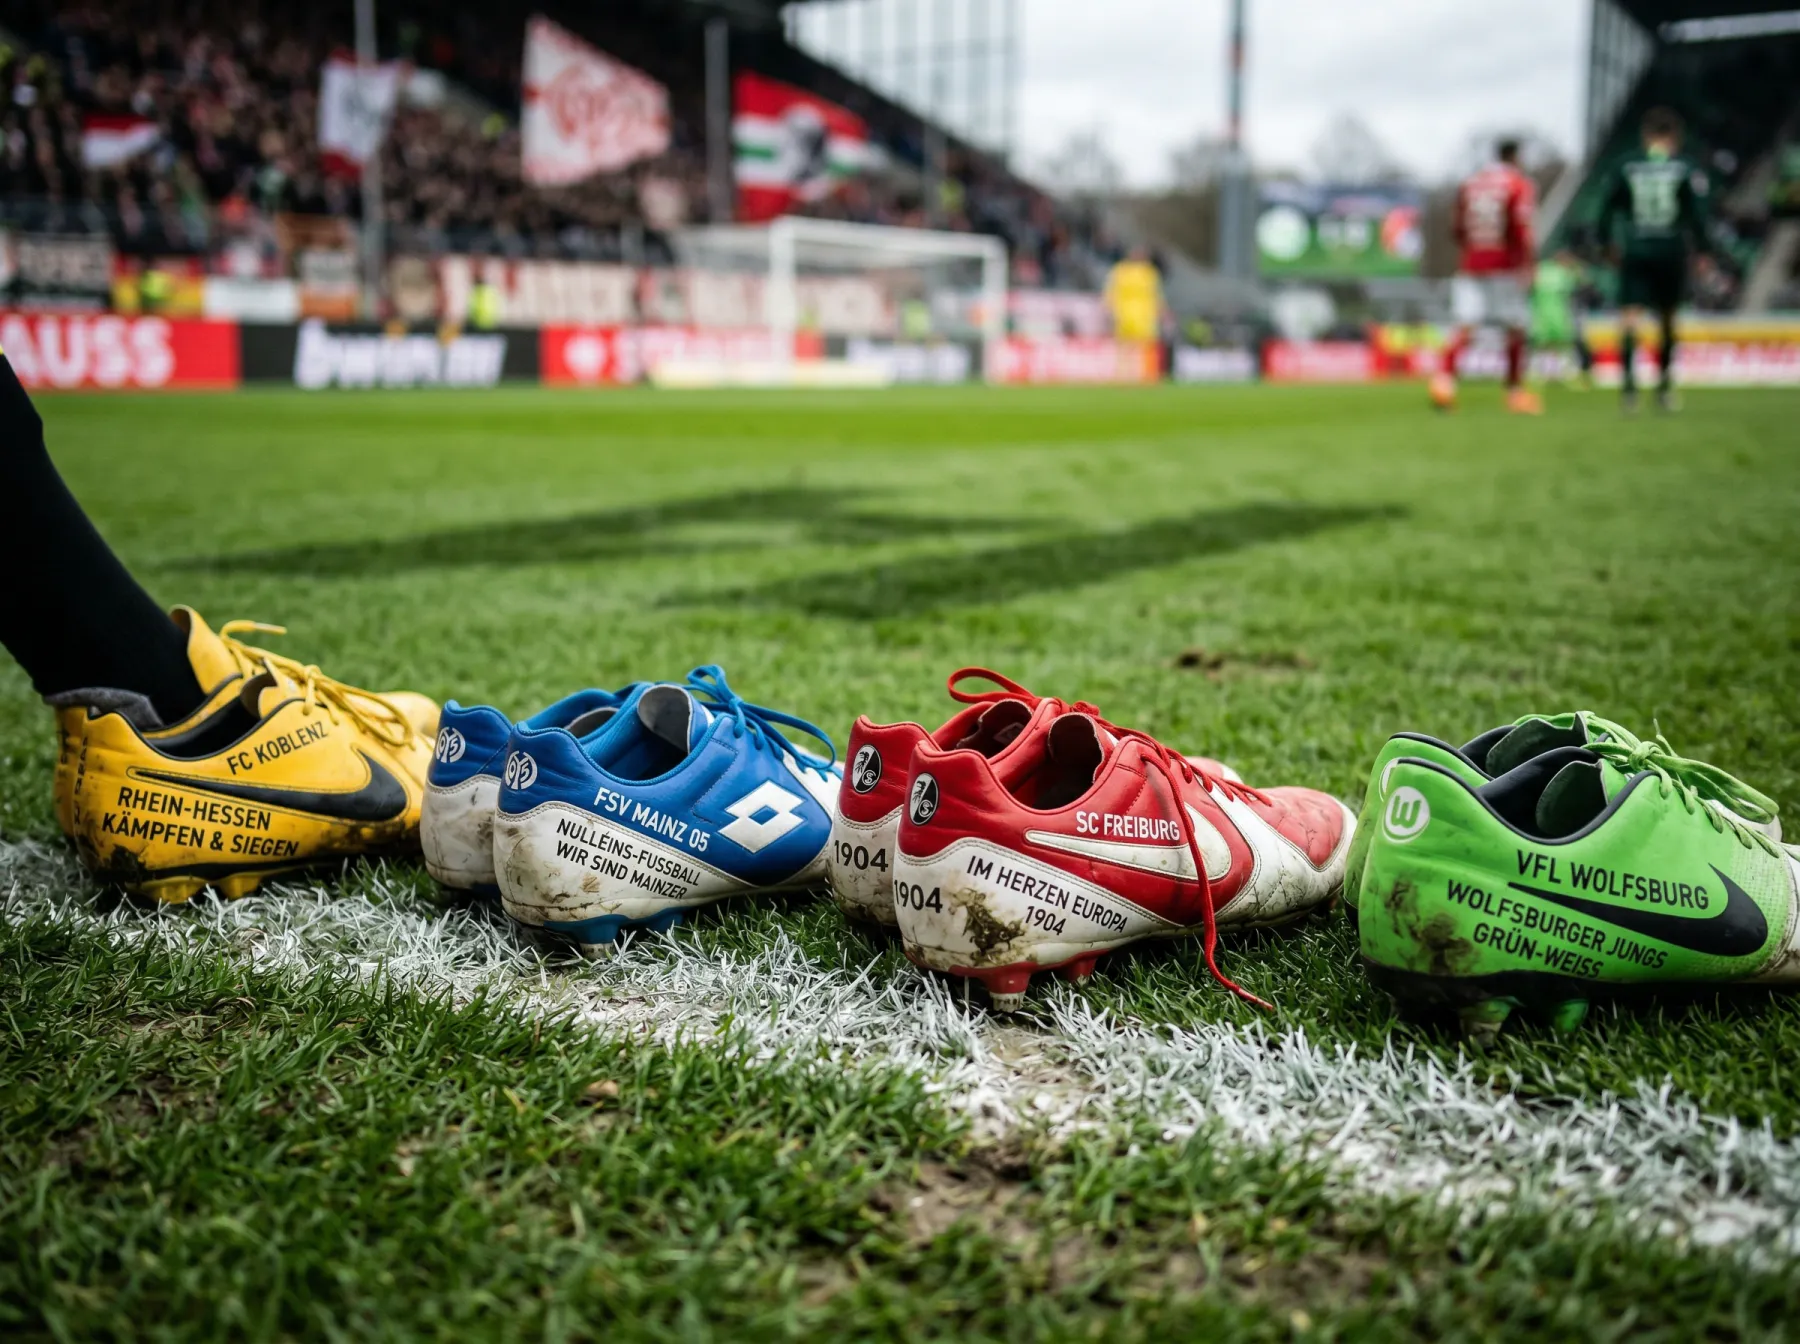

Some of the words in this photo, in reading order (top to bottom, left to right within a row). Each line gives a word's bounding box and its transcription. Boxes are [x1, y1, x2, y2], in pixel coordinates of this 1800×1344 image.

[226, 751, 253, 775] FC
[254, 721, 328, 764] KOBLENZ
[101, 811, 205, 848] KÄMPFEN
[209, 831, 224, 851] &
[230, 834, 299, 857] SIEGEN
[117, 786, 271, 831] RHEIN-HESSEN
[594, 787, 632, 816] FSV
[632, 803, 687, 843] MAINZ
[689, 828, 710, 852] 05
[1076, 811, 1099, 834] SC
[1103, 814, 1180, 841] FREIBURG
[556, 840, 589, 866] WIR
[590, 855, 628, 880] SIND
[629, 870, 687, 899] MAINZER
[834, 839, 889, 873] 1904
[1517, 849, 1561, 884] VFL
[1570, 861, 1709, 910] WOLFSBURG
[894, 879, 943, 914] 1904
[966, 855, 994, 880] IM
[996, 866, 1070, 910] HERZEN
[1071, 895, 1128, 933] EUROPA
[1025, 905, 1067, 936] 1904
[1448, 879, 1606, 950] WOLFSBURGER
[1607, 936, 1669, 969] JUNGS
[1473, 922, 1604, 978] GRÜN-WEISS
